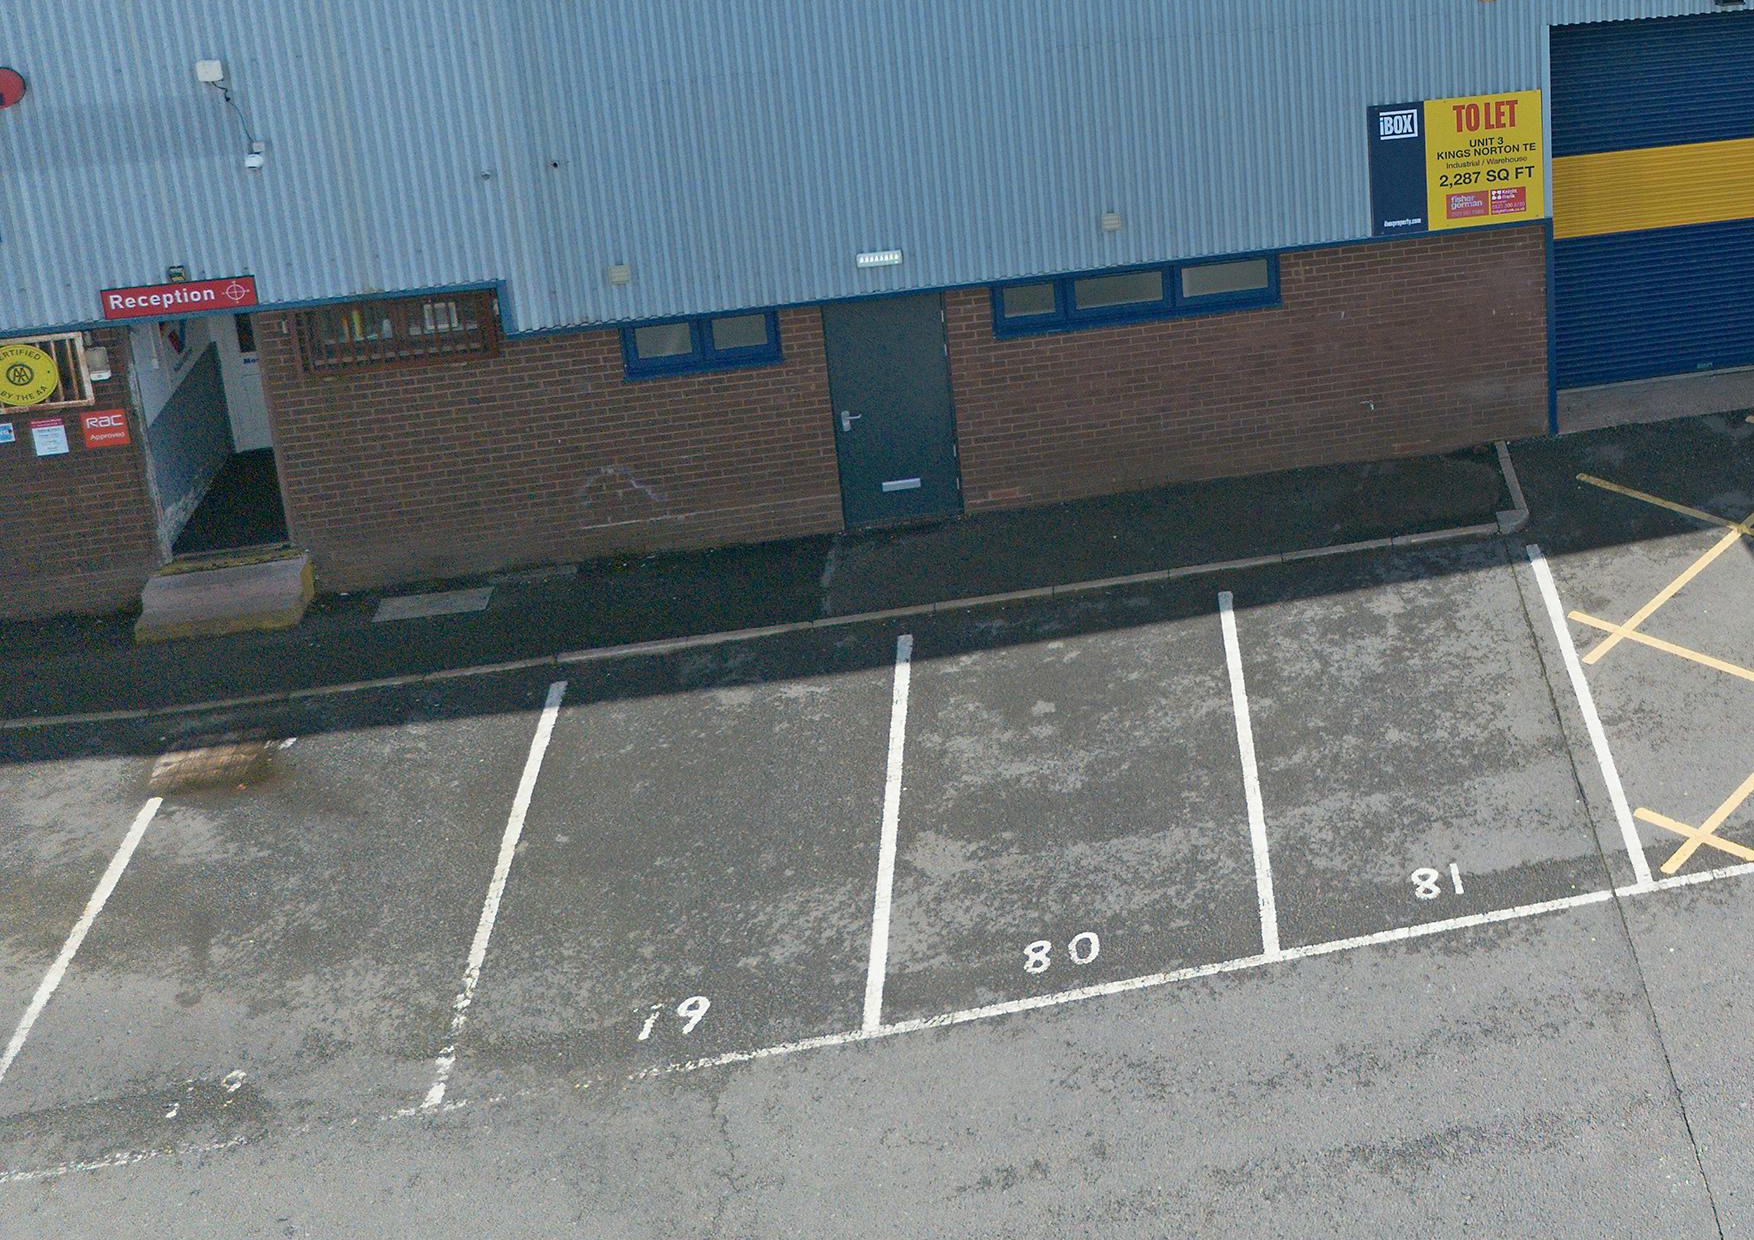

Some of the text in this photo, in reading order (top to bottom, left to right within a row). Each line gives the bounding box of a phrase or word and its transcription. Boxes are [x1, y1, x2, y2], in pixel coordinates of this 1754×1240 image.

[1379, 113, 1413, 136] iBOX
[1452, 99, 1518, 133] TO LET
[1437, 142, 1536, 160] KINGS NORTON TE
[1469, 136, 1504, 148] UNIT 3
[1446, 159, 1480, 169] Industrial
[1486, 156, 1528, 165] Warehouse
[1439, 165, 1535, 188] 2,287 SQ FT
[109, 288, 215, 310] Reception
[90, 431, 126, 441] Approved
[1411, 863, 1465, 900] 81
[1023, 932, 1100, 974] 80
